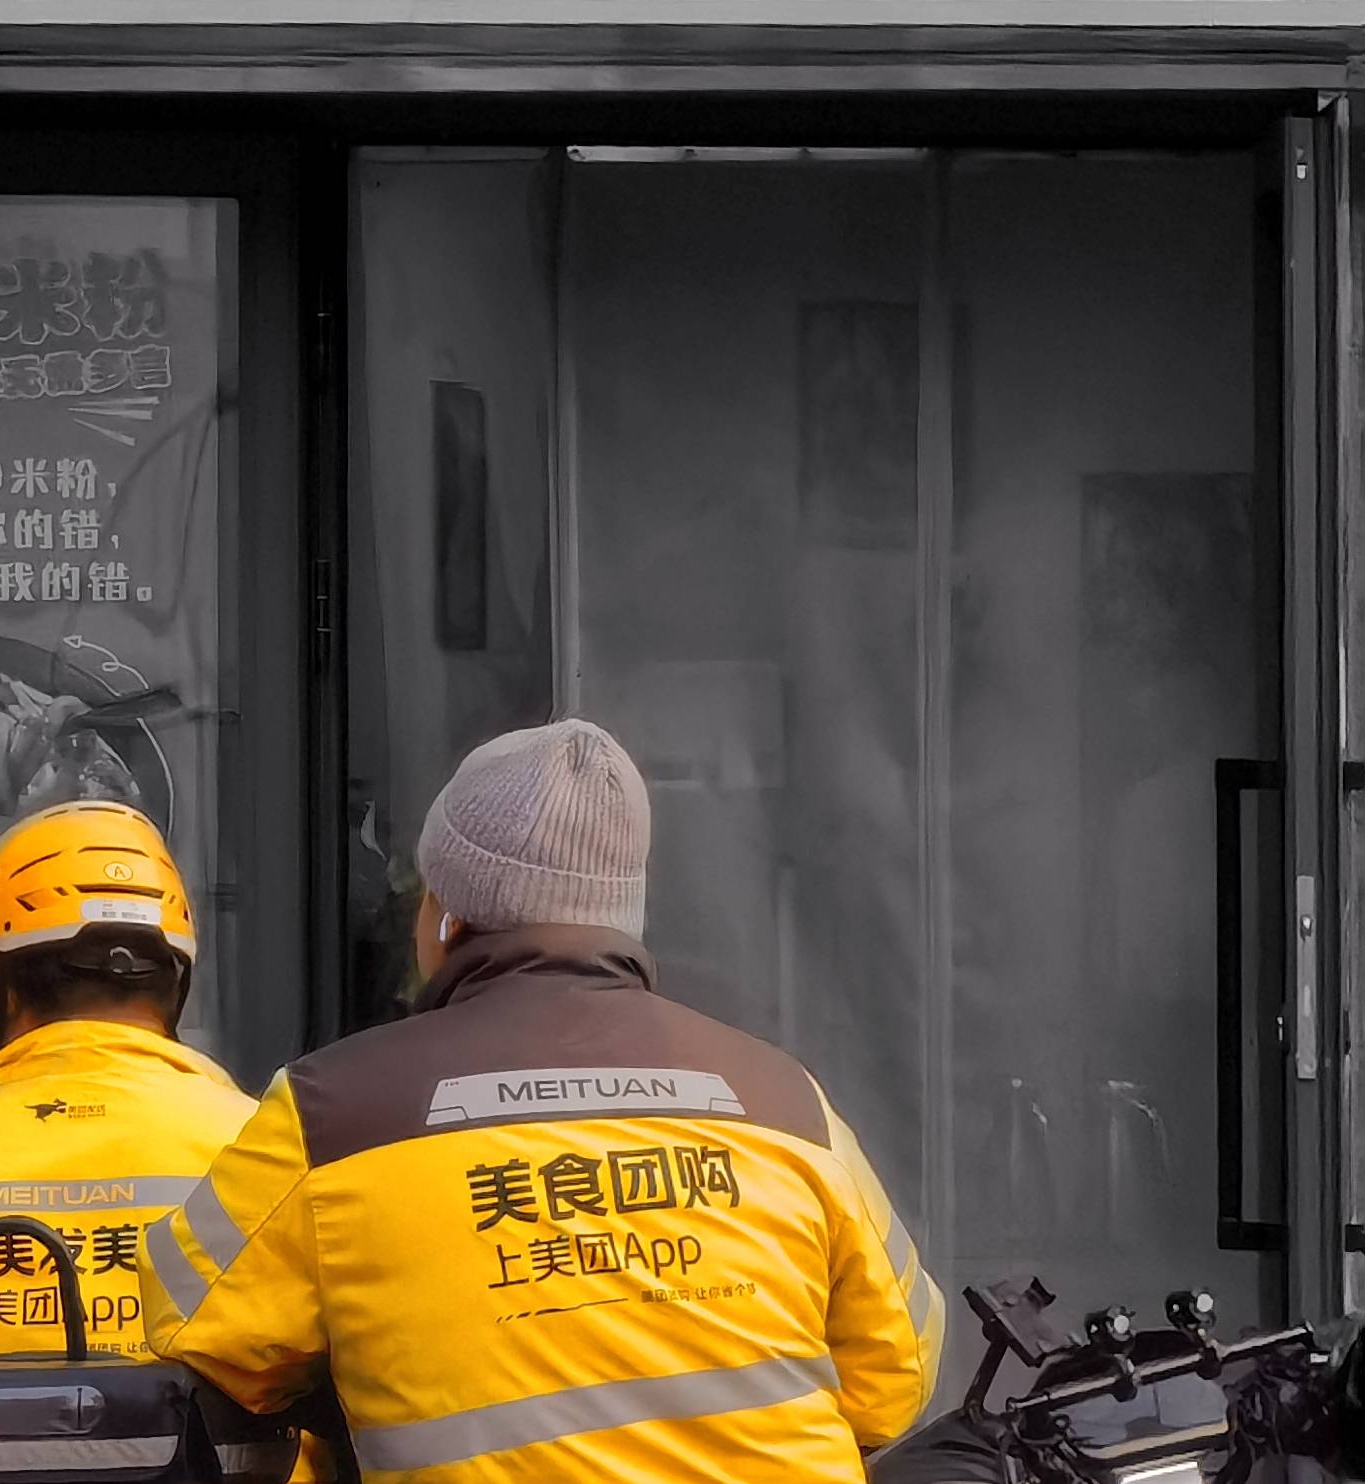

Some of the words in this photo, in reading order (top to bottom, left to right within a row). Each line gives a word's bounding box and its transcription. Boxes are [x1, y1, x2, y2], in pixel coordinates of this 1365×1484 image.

[497, 1078, 677, 1103] MEITUAN
[465, 1146, 741, 1232] 美食团购
[487, 1232, 702, 1290] 上美团App
